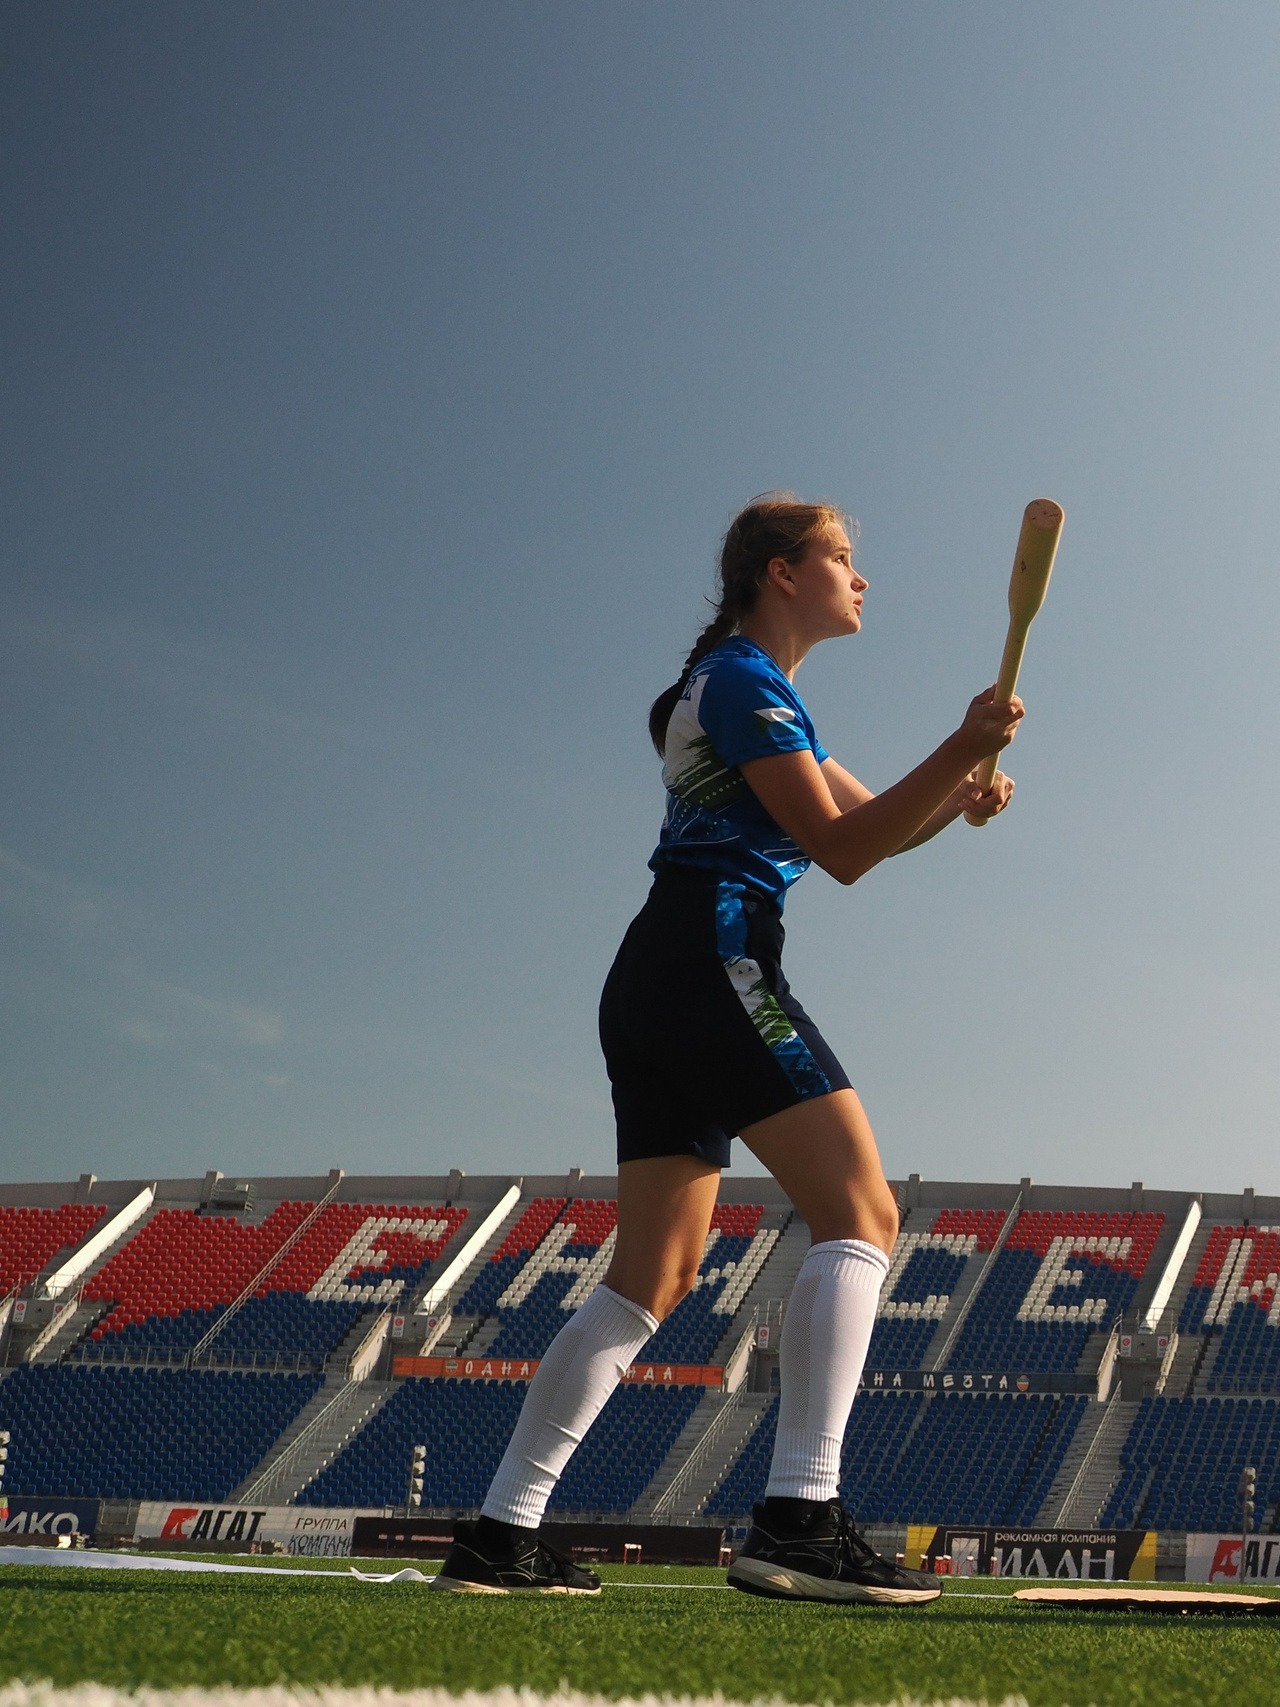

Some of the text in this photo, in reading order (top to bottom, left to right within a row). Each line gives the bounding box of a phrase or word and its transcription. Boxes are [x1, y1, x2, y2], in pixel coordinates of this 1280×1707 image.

[191, 1509, 266, 1540] АГАТ
[295, 1518, 347, 1530] ГРУППА
[287, 1534, 352, 1557] КОМПАН
[995, 1532, 1116, 1544] рекламная компания
